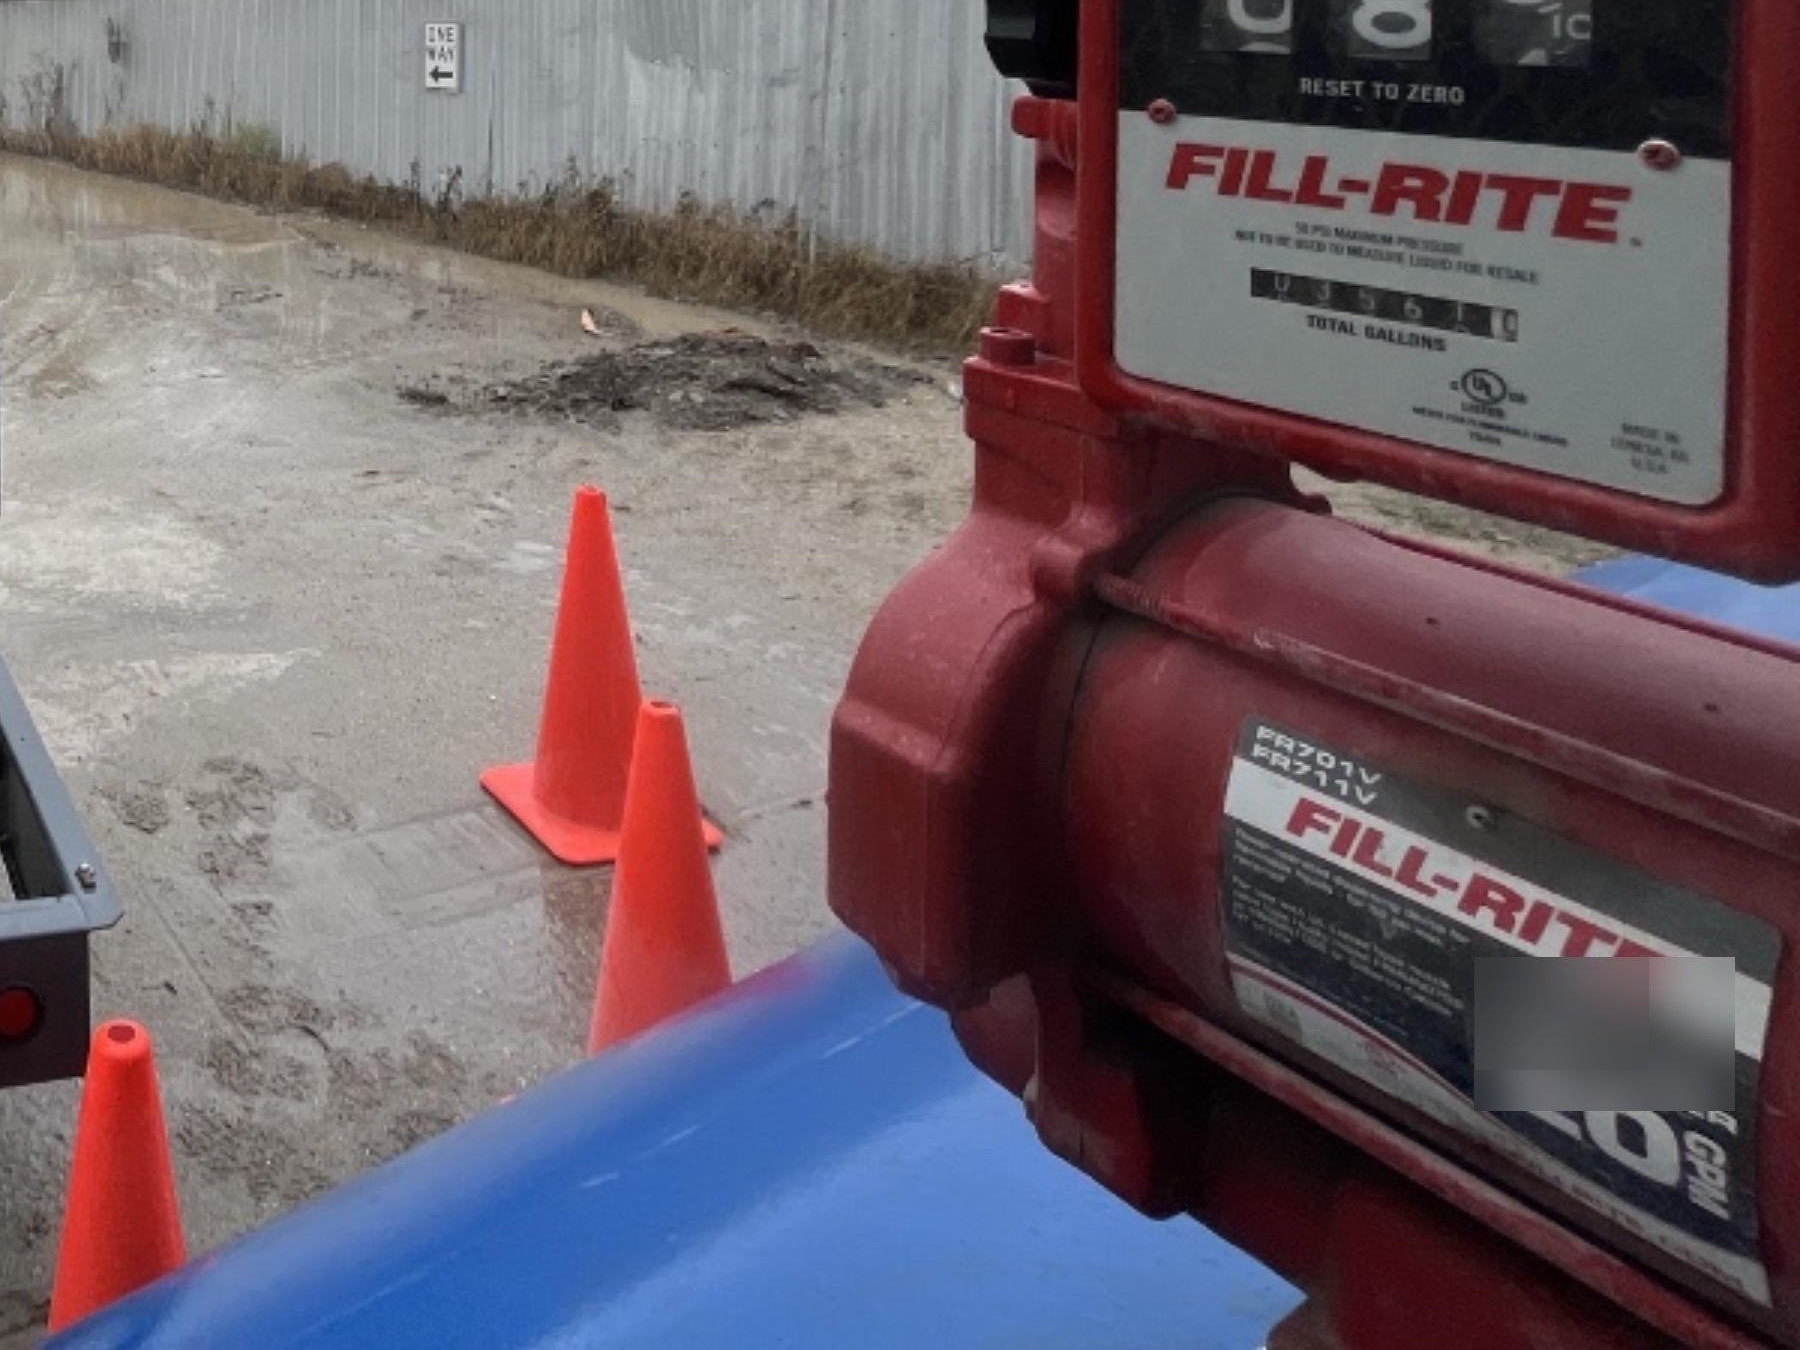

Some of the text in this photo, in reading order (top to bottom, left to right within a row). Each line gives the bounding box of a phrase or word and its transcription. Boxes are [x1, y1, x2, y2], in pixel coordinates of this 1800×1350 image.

[1299, 77, 1466, 107] RESET TO ZERO
[1165, 141, 1634, 245] FILL-RITE
[1306, 313, 1448, 352] TOTAL GALLONS
[1252, 742, 1378, 806] FR711V
[1255, 724, 1382, 786] FR701V
[1284, 796, 1671, 958] FILL-RIT
